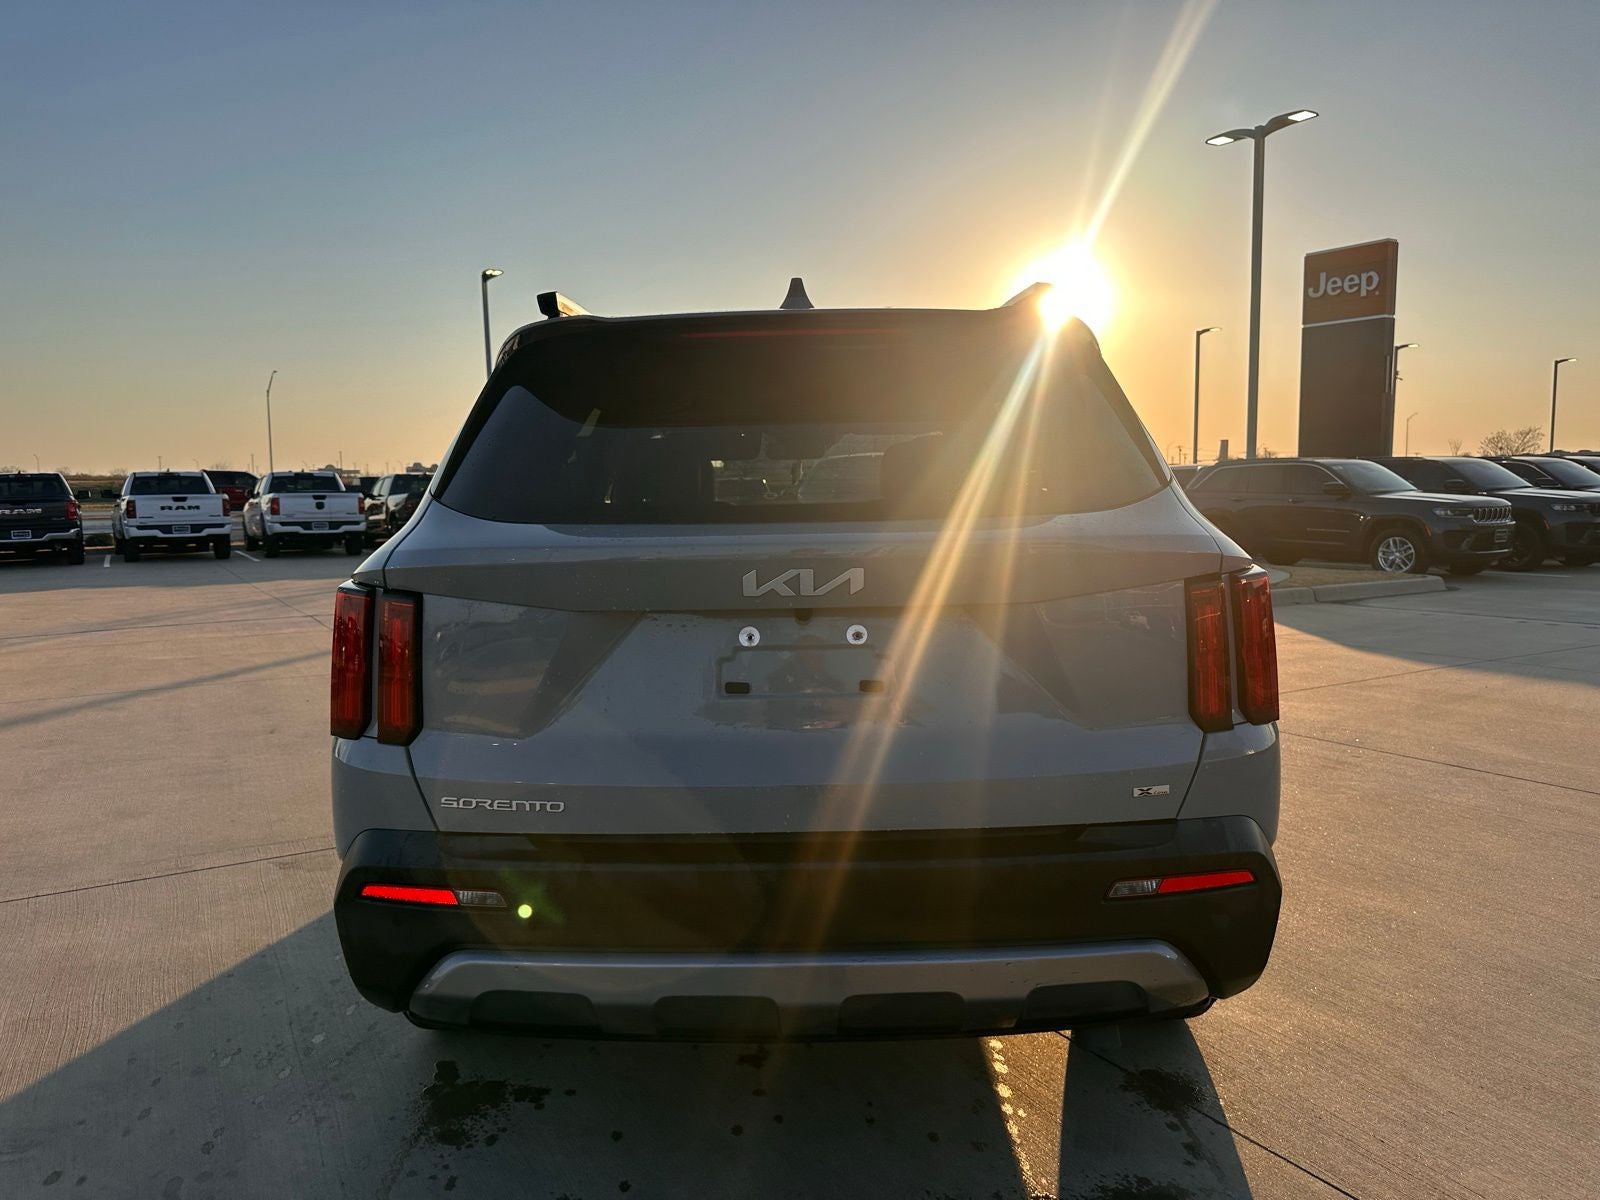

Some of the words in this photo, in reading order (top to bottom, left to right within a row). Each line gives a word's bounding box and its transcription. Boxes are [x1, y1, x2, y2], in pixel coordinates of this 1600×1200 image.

[1308, 271, 1379, 298] Jeep
[742, 567, 865, 597] KIA
[440, 796, 565, 813] SORENTO
